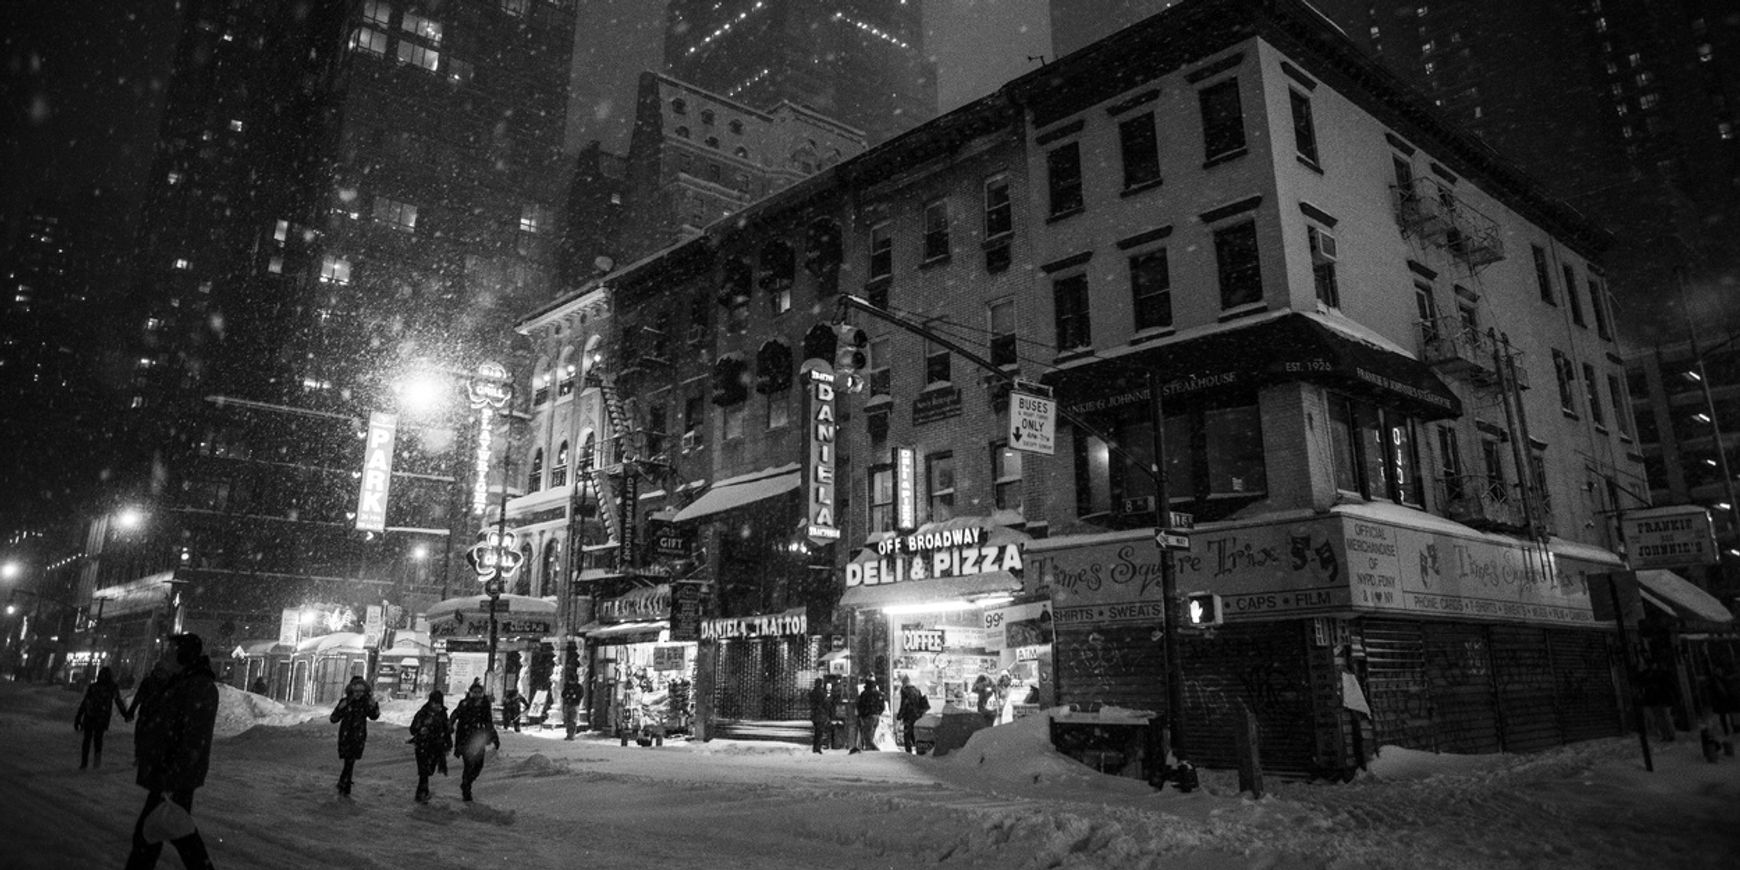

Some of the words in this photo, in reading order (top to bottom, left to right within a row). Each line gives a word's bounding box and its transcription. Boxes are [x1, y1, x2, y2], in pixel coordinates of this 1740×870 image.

[1285, 361, 1304, 372] EST.
[1162, 371, 1237, 396] STEAKHOUSE
[1019, 398, 1048, 414] BUSES
[1022, 418, 1045, 432] ONLY
[816, 383, 834, 526] DANIELA
[363, 427, 389, 512] PARK
[1354, 523, 1387, 541] OFFICIAL
[1637, 519, 1693, 534] FRANKIE
[659, 537, 683, 549] GIFT
[878, 538, 901, 556] OFF
[907, 527, 980, 551] BROADWAY
[1638, 541, 1703, 557] JOHNNIE'S
[846, 558, 903, 587] DELI
[910, 556, 927, 580] &
[933, 543, 1023, 578] PIZZA
[1031, 555, 1102, 595] Times
[1111, 545, 1203, 597] Squre
[1208, 538, 1279, 578] Trix
[1368, 557, 1379, 570] OF
[1109, 603, 1161, 619] SWEATS
[1236, 595, 1277, 610] CAPS
[1295, 592, 1331, 606] FILM
[700, 618, 747, 640] DANIELA
[903, 630, 943, 650] COFFEE
[1018, 648, 1038, 661] ATM
